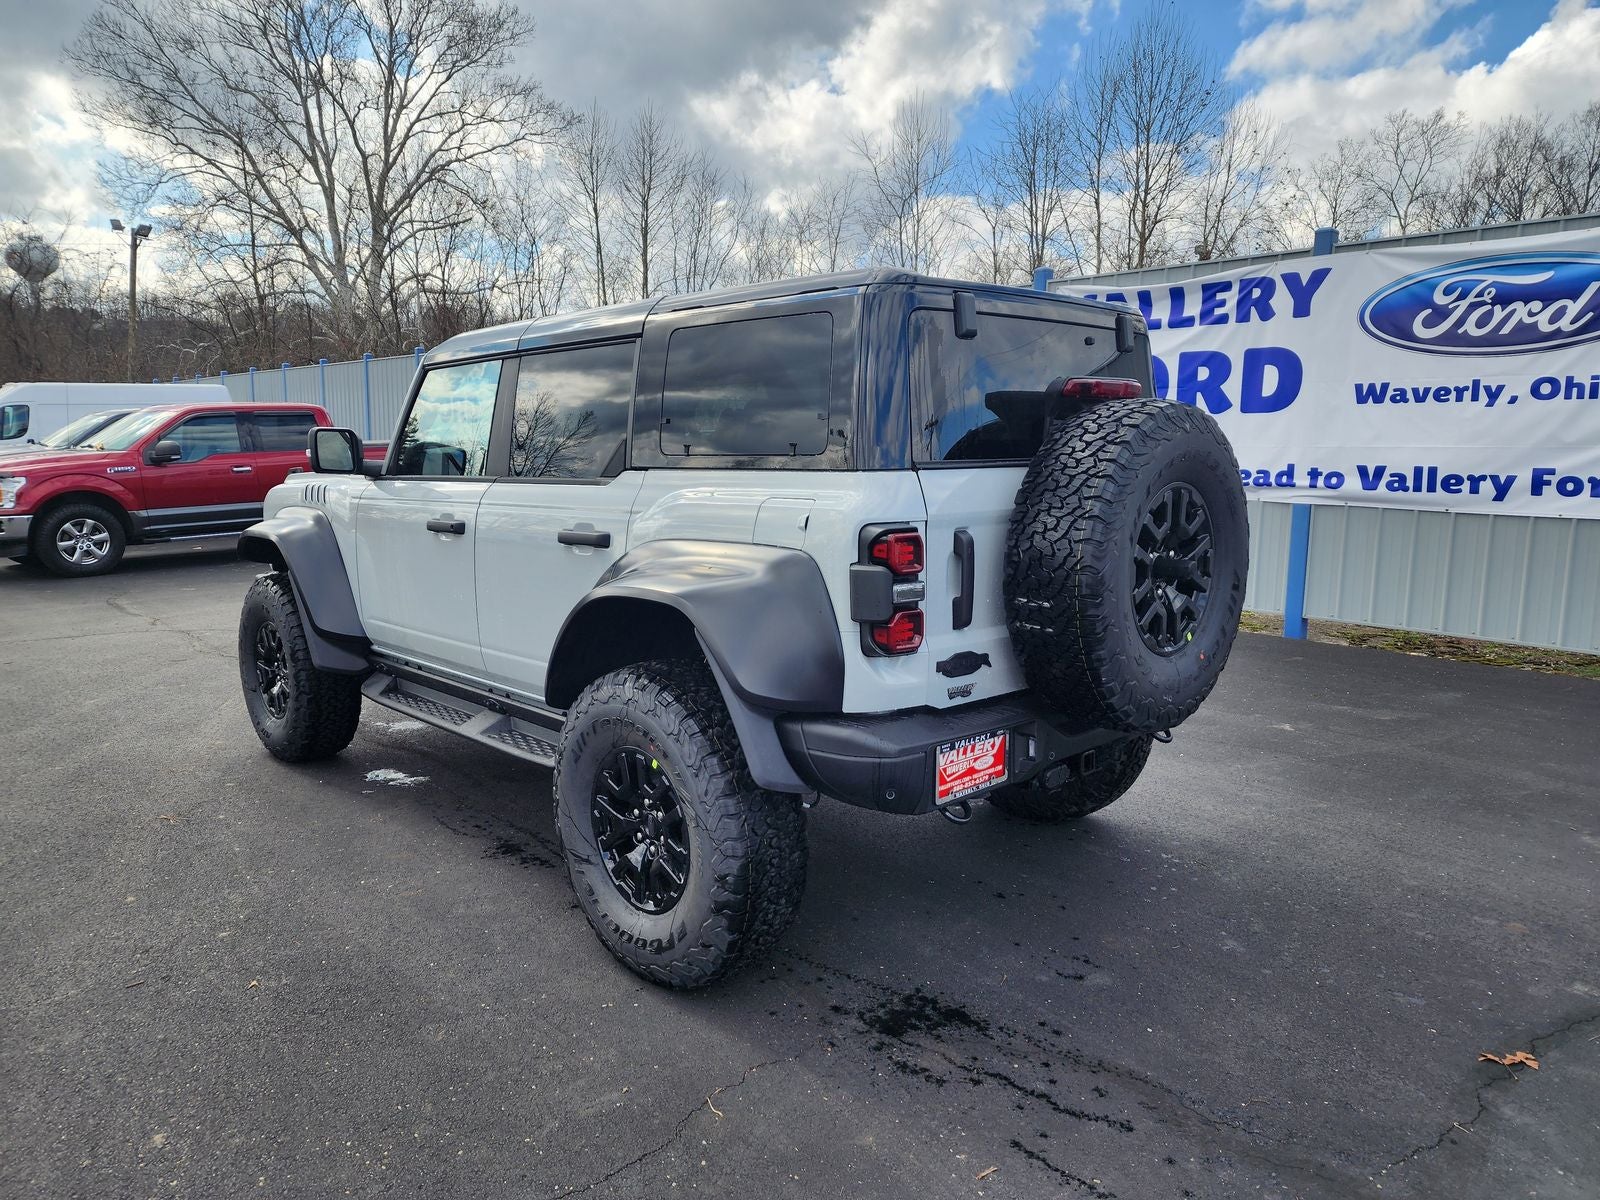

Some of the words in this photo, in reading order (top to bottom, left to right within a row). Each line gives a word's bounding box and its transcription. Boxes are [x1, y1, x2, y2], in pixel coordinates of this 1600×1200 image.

[1083, 267, 1333, 331] LLERY
[1412, 270, 1600, 339] Ford
[1151, 347, 1303, 415] RD
[1354, 379, 1519, 407] Waverly,
[1307, 467, 1346, 489] to
[1356, 464, 1518, 502] Vallery
[939, 734, 1004, 766] VALLERY
